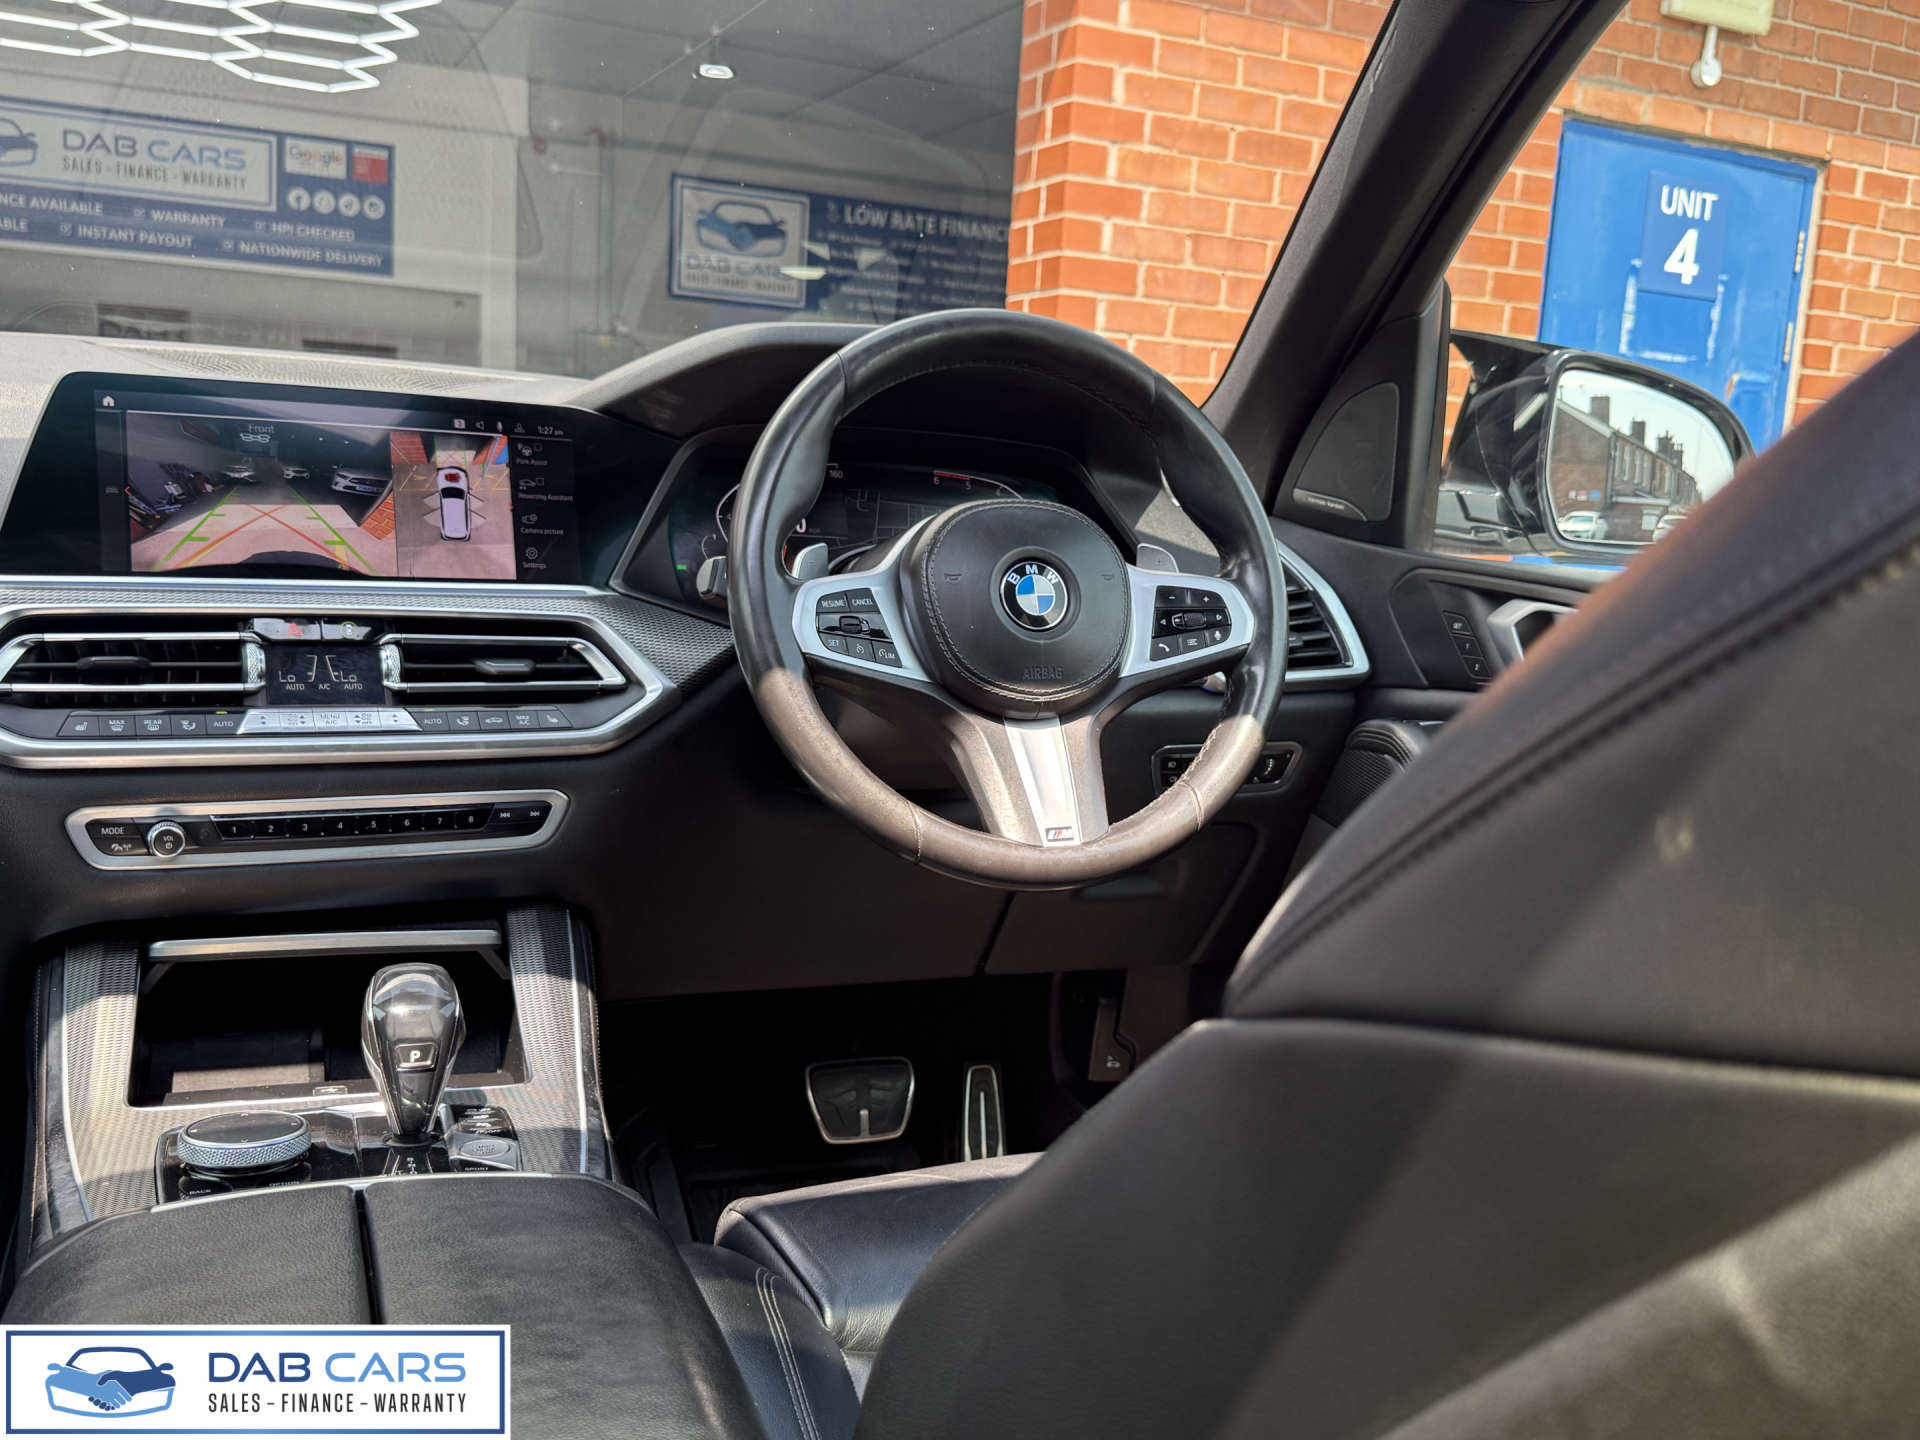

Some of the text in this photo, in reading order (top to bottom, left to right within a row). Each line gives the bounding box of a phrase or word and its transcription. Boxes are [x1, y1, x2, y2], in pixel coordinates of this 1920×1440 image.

[63, 129, 247, 172] DAB CARS
[63, 156, 102, 174] SALES
[116, 162, 168, 183] FINANCE
[183, 170, 247, 190] WARRANTY
[30, 196, 104, 217] AVAILABLE
[1660, 184, 1719, 222] UNIT
[151, 208, 227, 228] WARRANTY
[844, 203, 888, 228] LOW
[890, 210, 937, 235] RATE
[78, 223, 194, 249] INSTANT PAYOUT
[271, 220, 356, 242] HPI CHECKED
[239, 241, 384, 268] NATIONWIDE DELIVERY
[1663, 227, 1700, 286] 4
[248, 423, 275, 434] Front
[537, 425, 554, 435] 1:27
[1007, 563, 1060, 585] BMW
[821, 600, 846, 608] RESUME
[851, 598, 873, 606] CANCEL
[1021, 665, 1064, 681] AIRBAG
[285, 683, 305, 691] AUTO
[318, 683, 331, 691] A/C
[343, 682, 363, 691] AUTO
[213, 720, 234, 728] AUTO
[101, 826, 125, 835] MODE
[231, 826, 237, 834] 1
[302, 823, 308, 832] 3
[337, 821, 343, 829] 4
[370, 820, 377, 829] 5
[404, 818, 410, 826] 6
[437, 817, 443, 825] 7
[468, 815, 474, 823] 8
[410, 1050, 421, 1063] P
